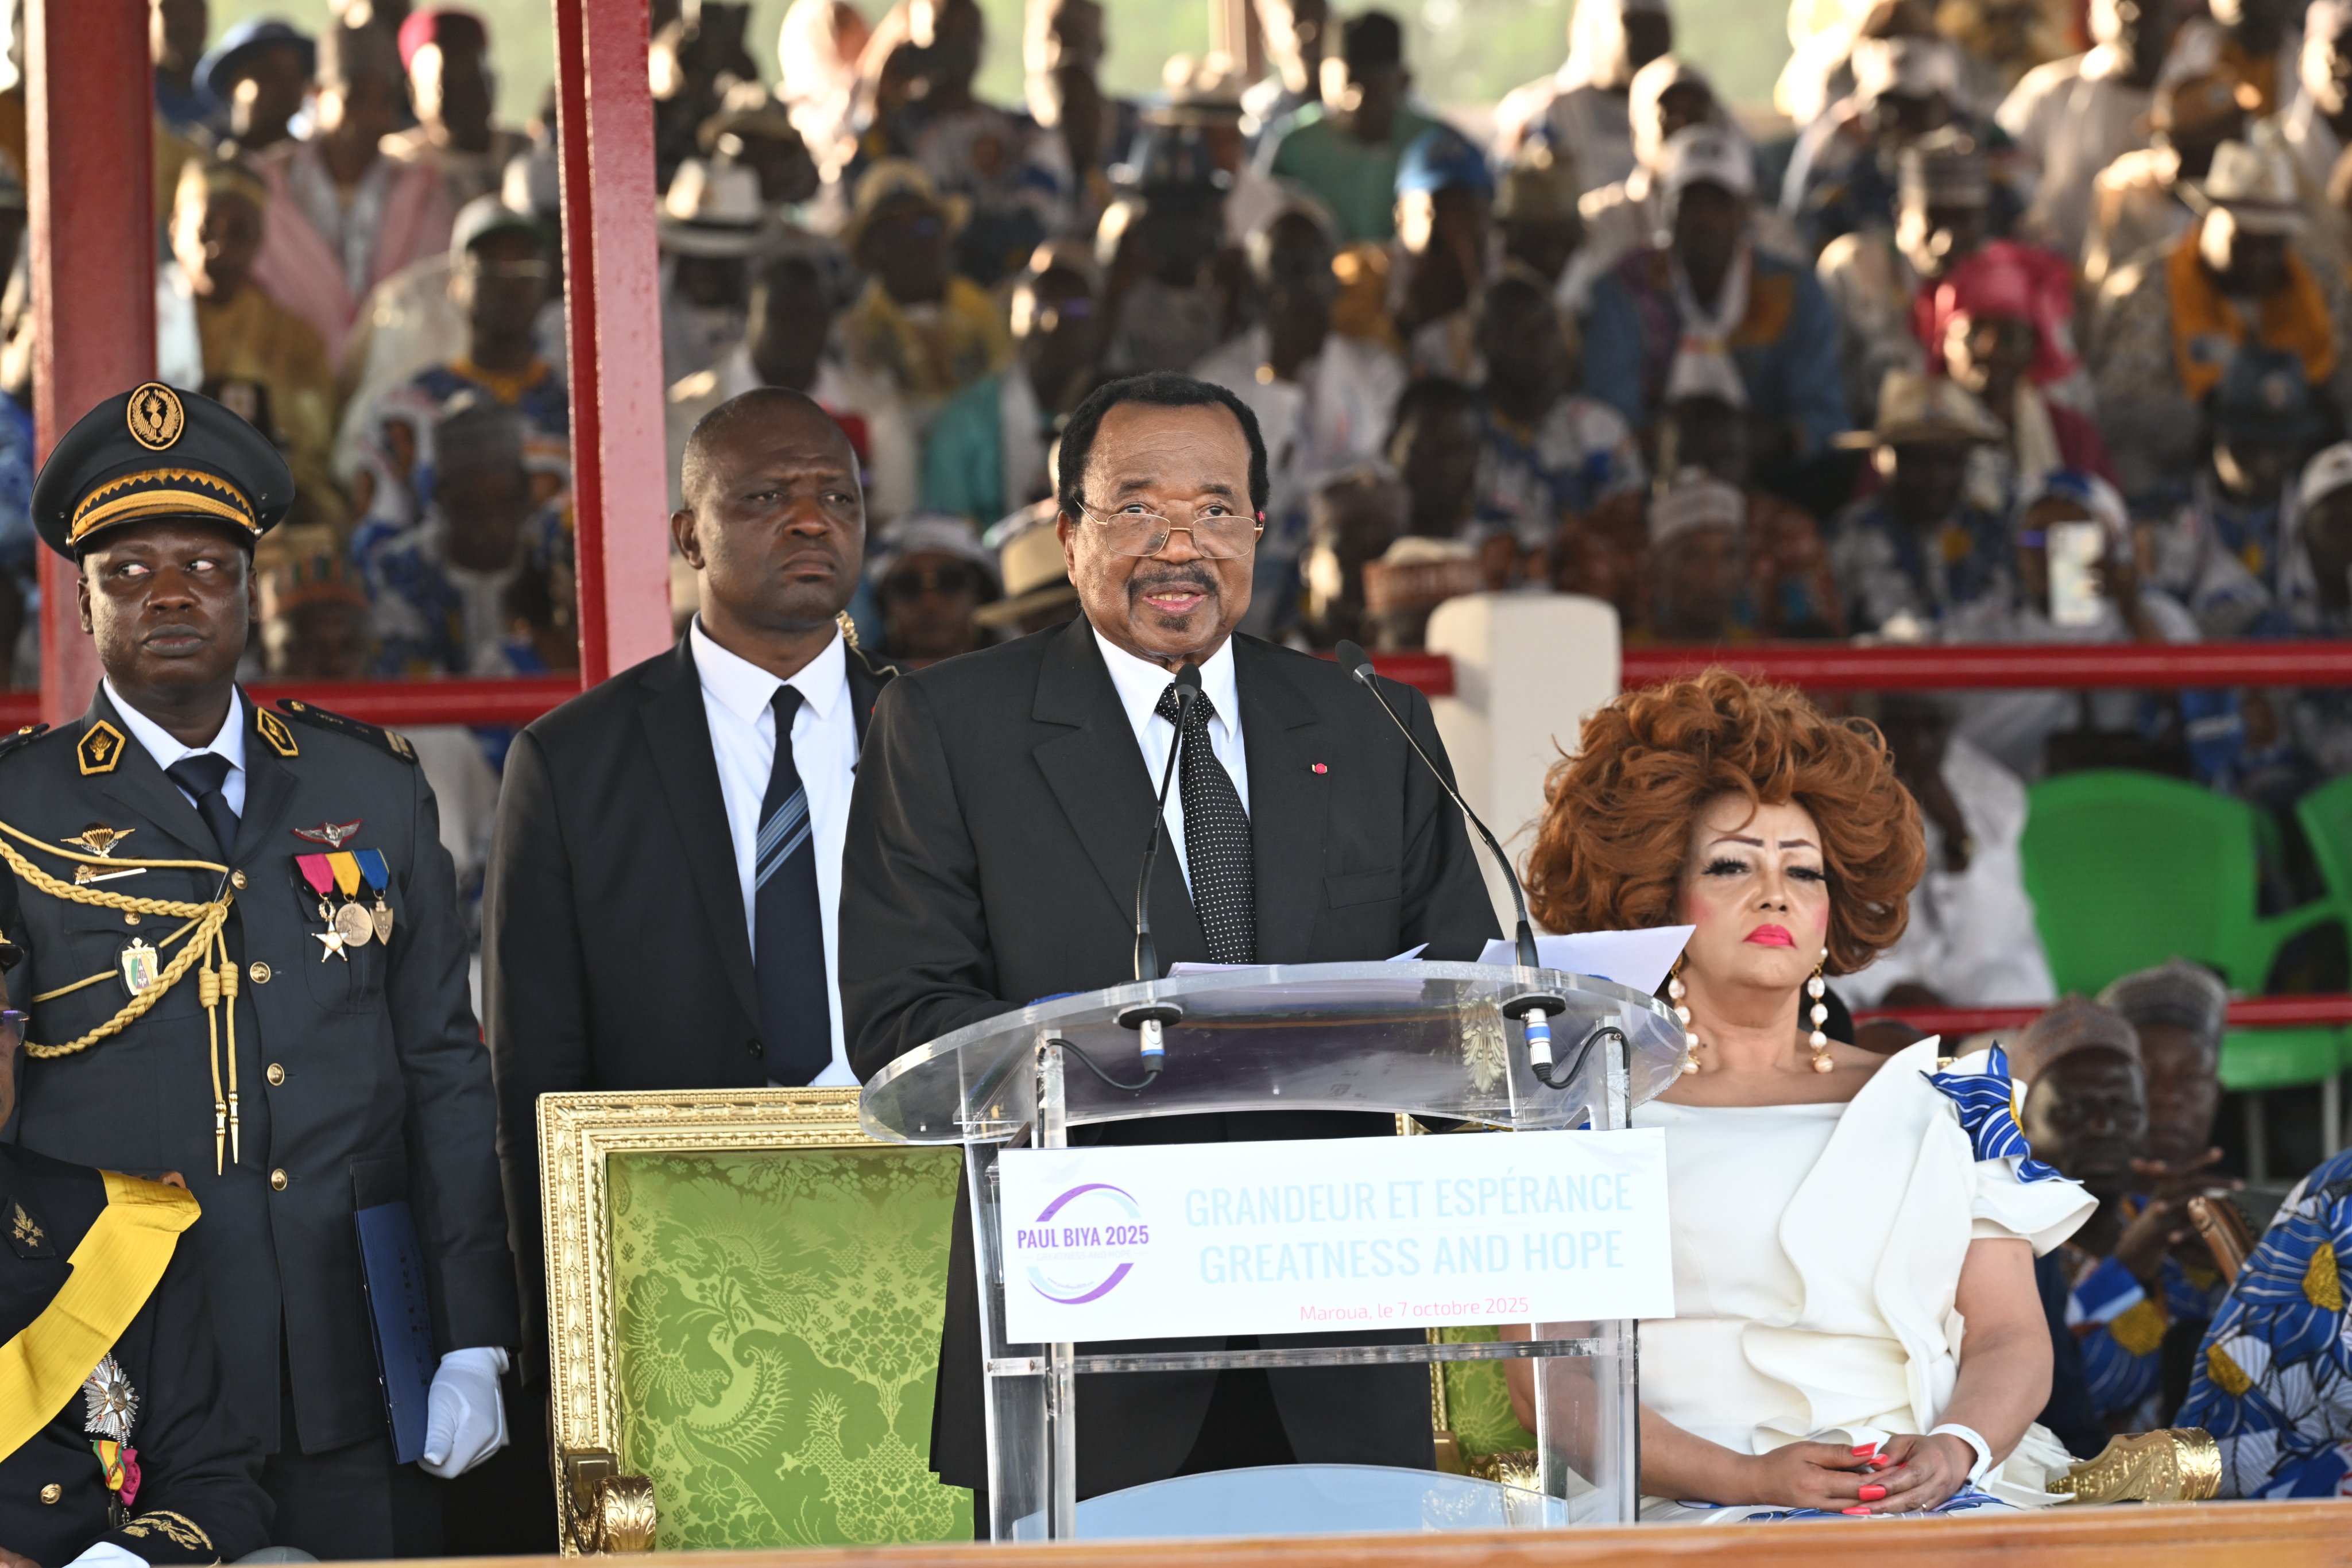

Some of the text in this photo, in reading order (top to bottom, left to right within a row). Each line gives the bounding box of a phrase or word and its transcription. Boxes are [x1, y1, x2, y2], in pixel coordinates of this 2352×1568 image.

[1186, 1167, 1632, 1227] GRANDEUR ET ESPÉRANCE
[1018, 1225, 1149, 1248] PAUL BIYA 2025
[1036, 1252, 1086, 1261] GREATNESS
[1109, 1249, 1131, 1259] HOPE
[1200, 1230, 1623, 1284] GREATNESS AND HOPE
[1301, 1297, 1529, 1322] Maroua, le 7 octobre 2025
